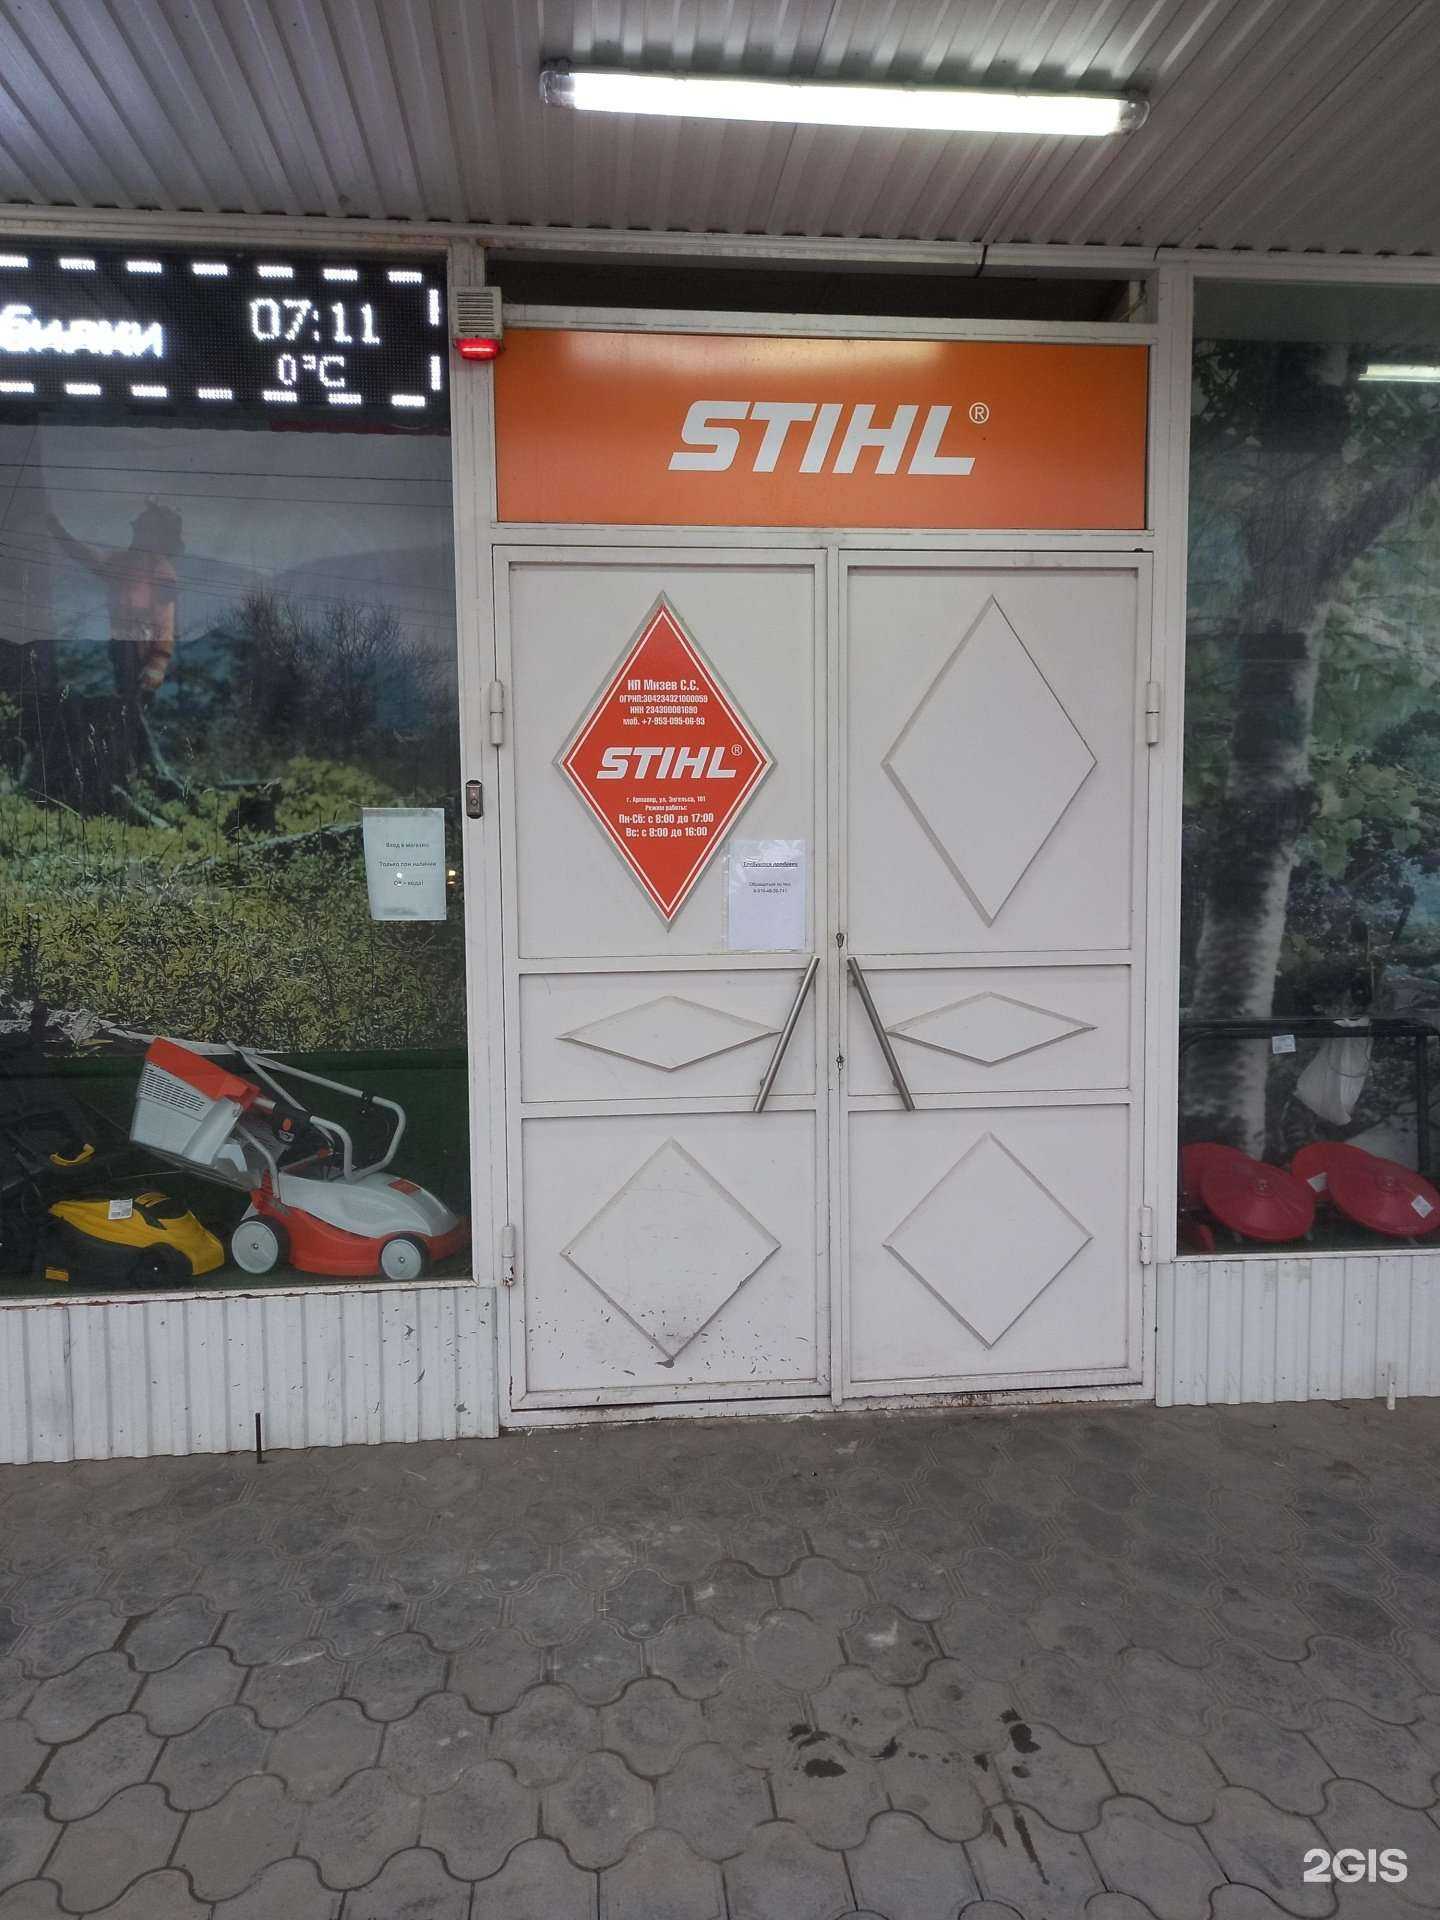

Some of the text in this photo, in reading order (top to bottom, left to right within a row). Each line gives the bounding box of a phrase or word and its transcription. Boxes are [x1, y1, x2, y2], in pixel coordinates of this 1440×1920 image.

[249, 298, 381, 345] 07:11
[667, 400, 976, 476] STIHL
[627, 679, 641, 691] ИП
[680, 679, 699, 691] С.С.
[596, 746, 737, 779] STIHL
[619, 812, 714, 825] Пн-Сб: с 8:00 до 17:00
[625, 826, 707, 838] Вс: с 8:00 до 16:00
